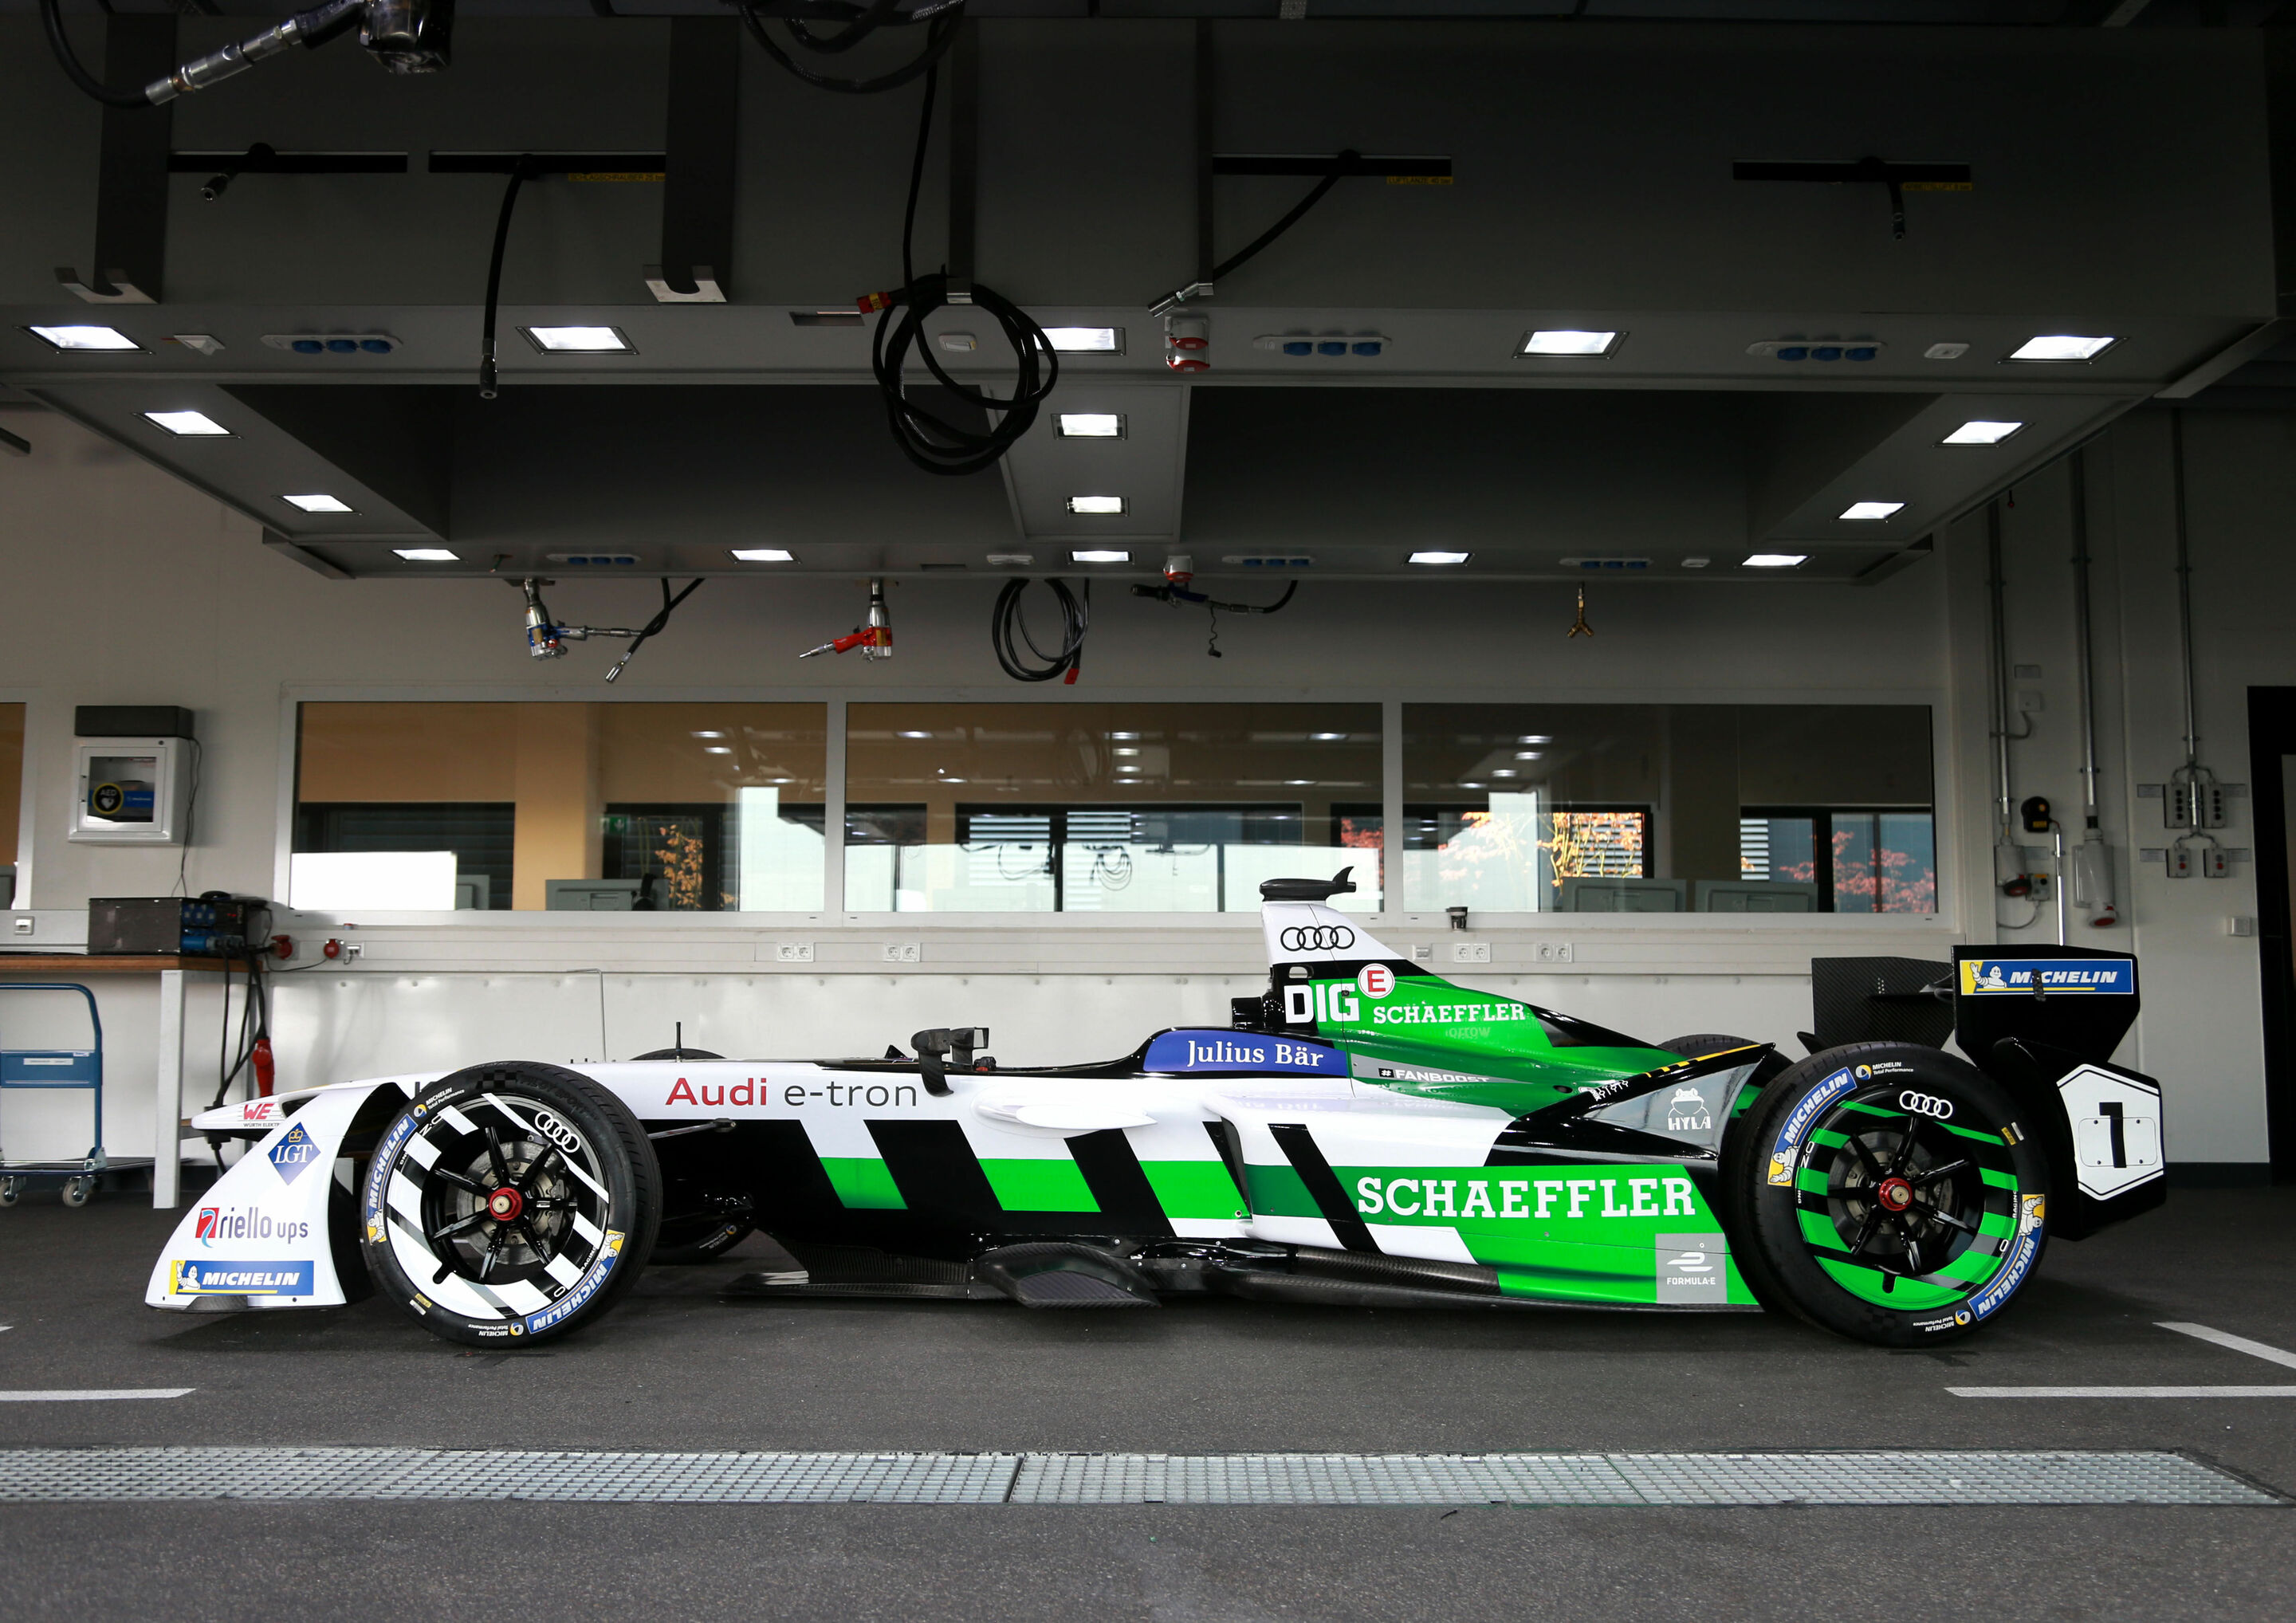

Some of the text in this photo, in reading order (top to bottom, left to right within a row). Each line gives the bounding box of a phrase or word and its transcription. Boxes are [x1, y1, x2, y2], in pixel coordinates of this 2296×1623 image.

[1366, 969, 1386, 992] E
[2009, 971, 2117, 984] MCHELIN
[1284, 983, 1360, 1024] DIG
[1373, 1003, 1526, 1024] SCHAEFFLER
[1186, 1039, 1324, 1067] Julius Bär
[425, 1087, 453, 1106] MICHELIN
[665, 1077, 917, 1106] Audi e-tron
[242, 1102, 274, 1120] WE
[1783, 1072, 1849, 1145] MICHELIN
[1668, 1116, 1712, 1131] HYLA
[2098, 1102, 2127, 1169] 1
[273, 1144, 313, 1165] LGT
[368, 1117, 410, 1209] MICHELIN
[1356, 1177, 1696, 1218] SCHAEFFLER
[218, 1206, 309, 1244] riello ups
[202, 1271, 301, 1286] MICHELIN
[1977, 1237, 2035, 1315] MICHELIN
[533, 1263, 608, 1330] MICHELIN
[1925, 1320, 1955, 1332] MICHELIN
